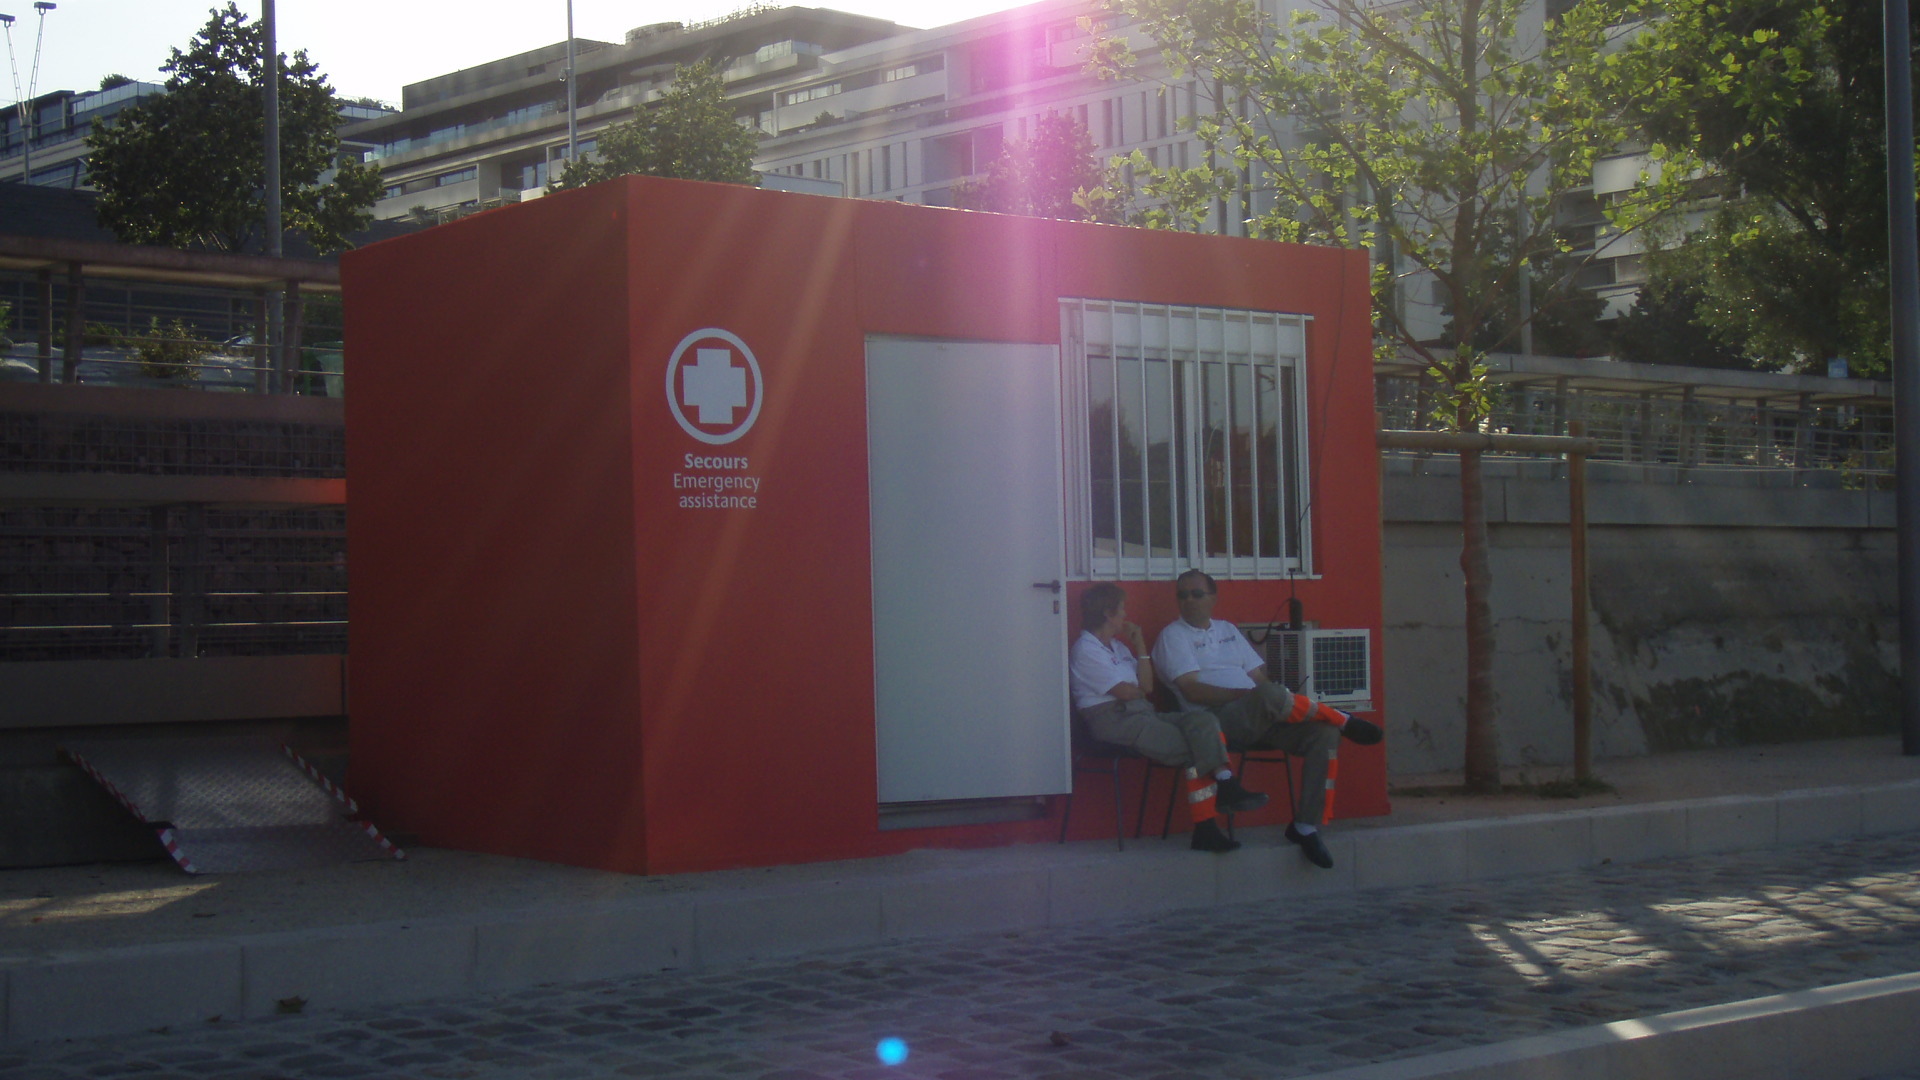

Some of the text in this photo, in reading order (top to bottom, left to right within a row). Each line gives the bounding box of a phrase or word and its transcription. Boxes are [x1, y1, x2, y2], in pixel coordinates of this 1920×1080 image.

[684, 453, 748, 469] Secours
[673, 473, 760, 493] Emergency
[679, 492, 757, 508] assistance
